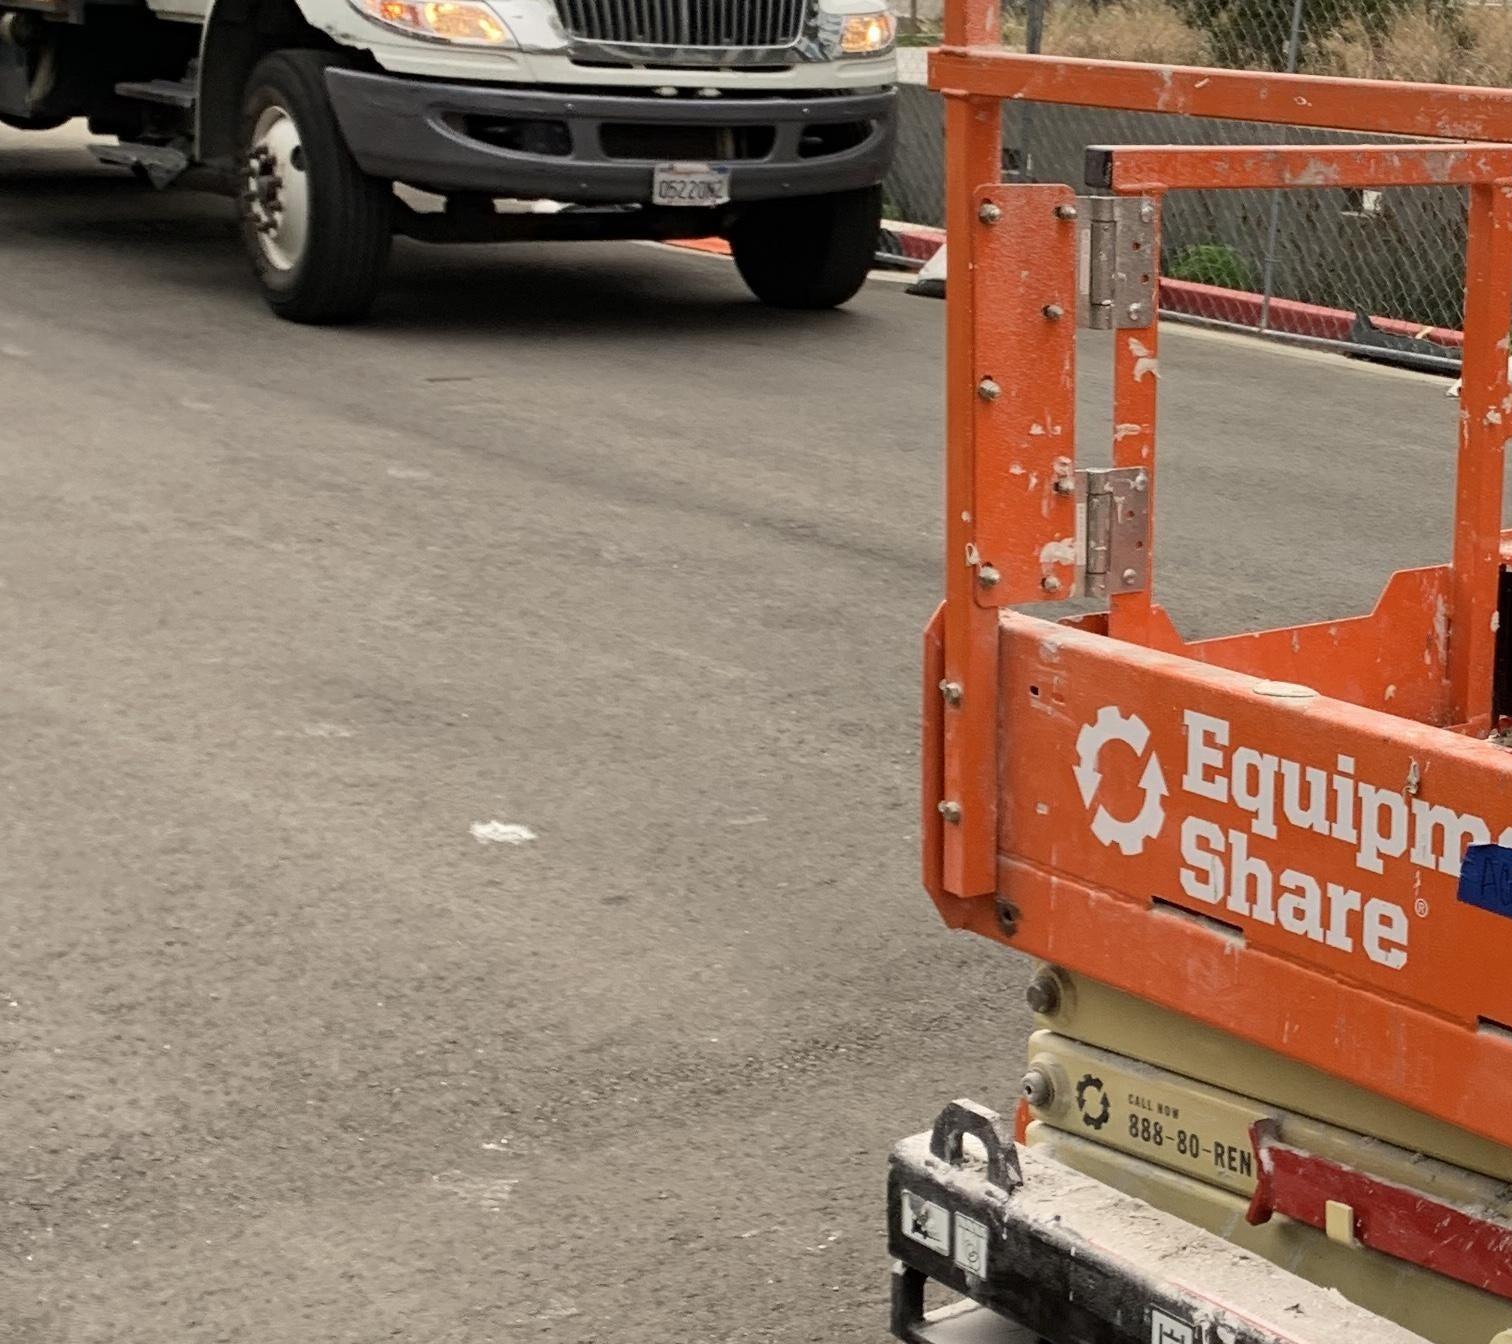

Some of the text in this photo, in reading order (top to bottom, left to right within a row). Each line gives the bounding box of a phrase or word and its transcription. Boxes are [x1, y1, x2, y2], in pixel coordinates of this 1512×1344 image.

[1179, 815, 1408, 970] Share
[1128, 1093, 1179, 1119] CALL NOW
